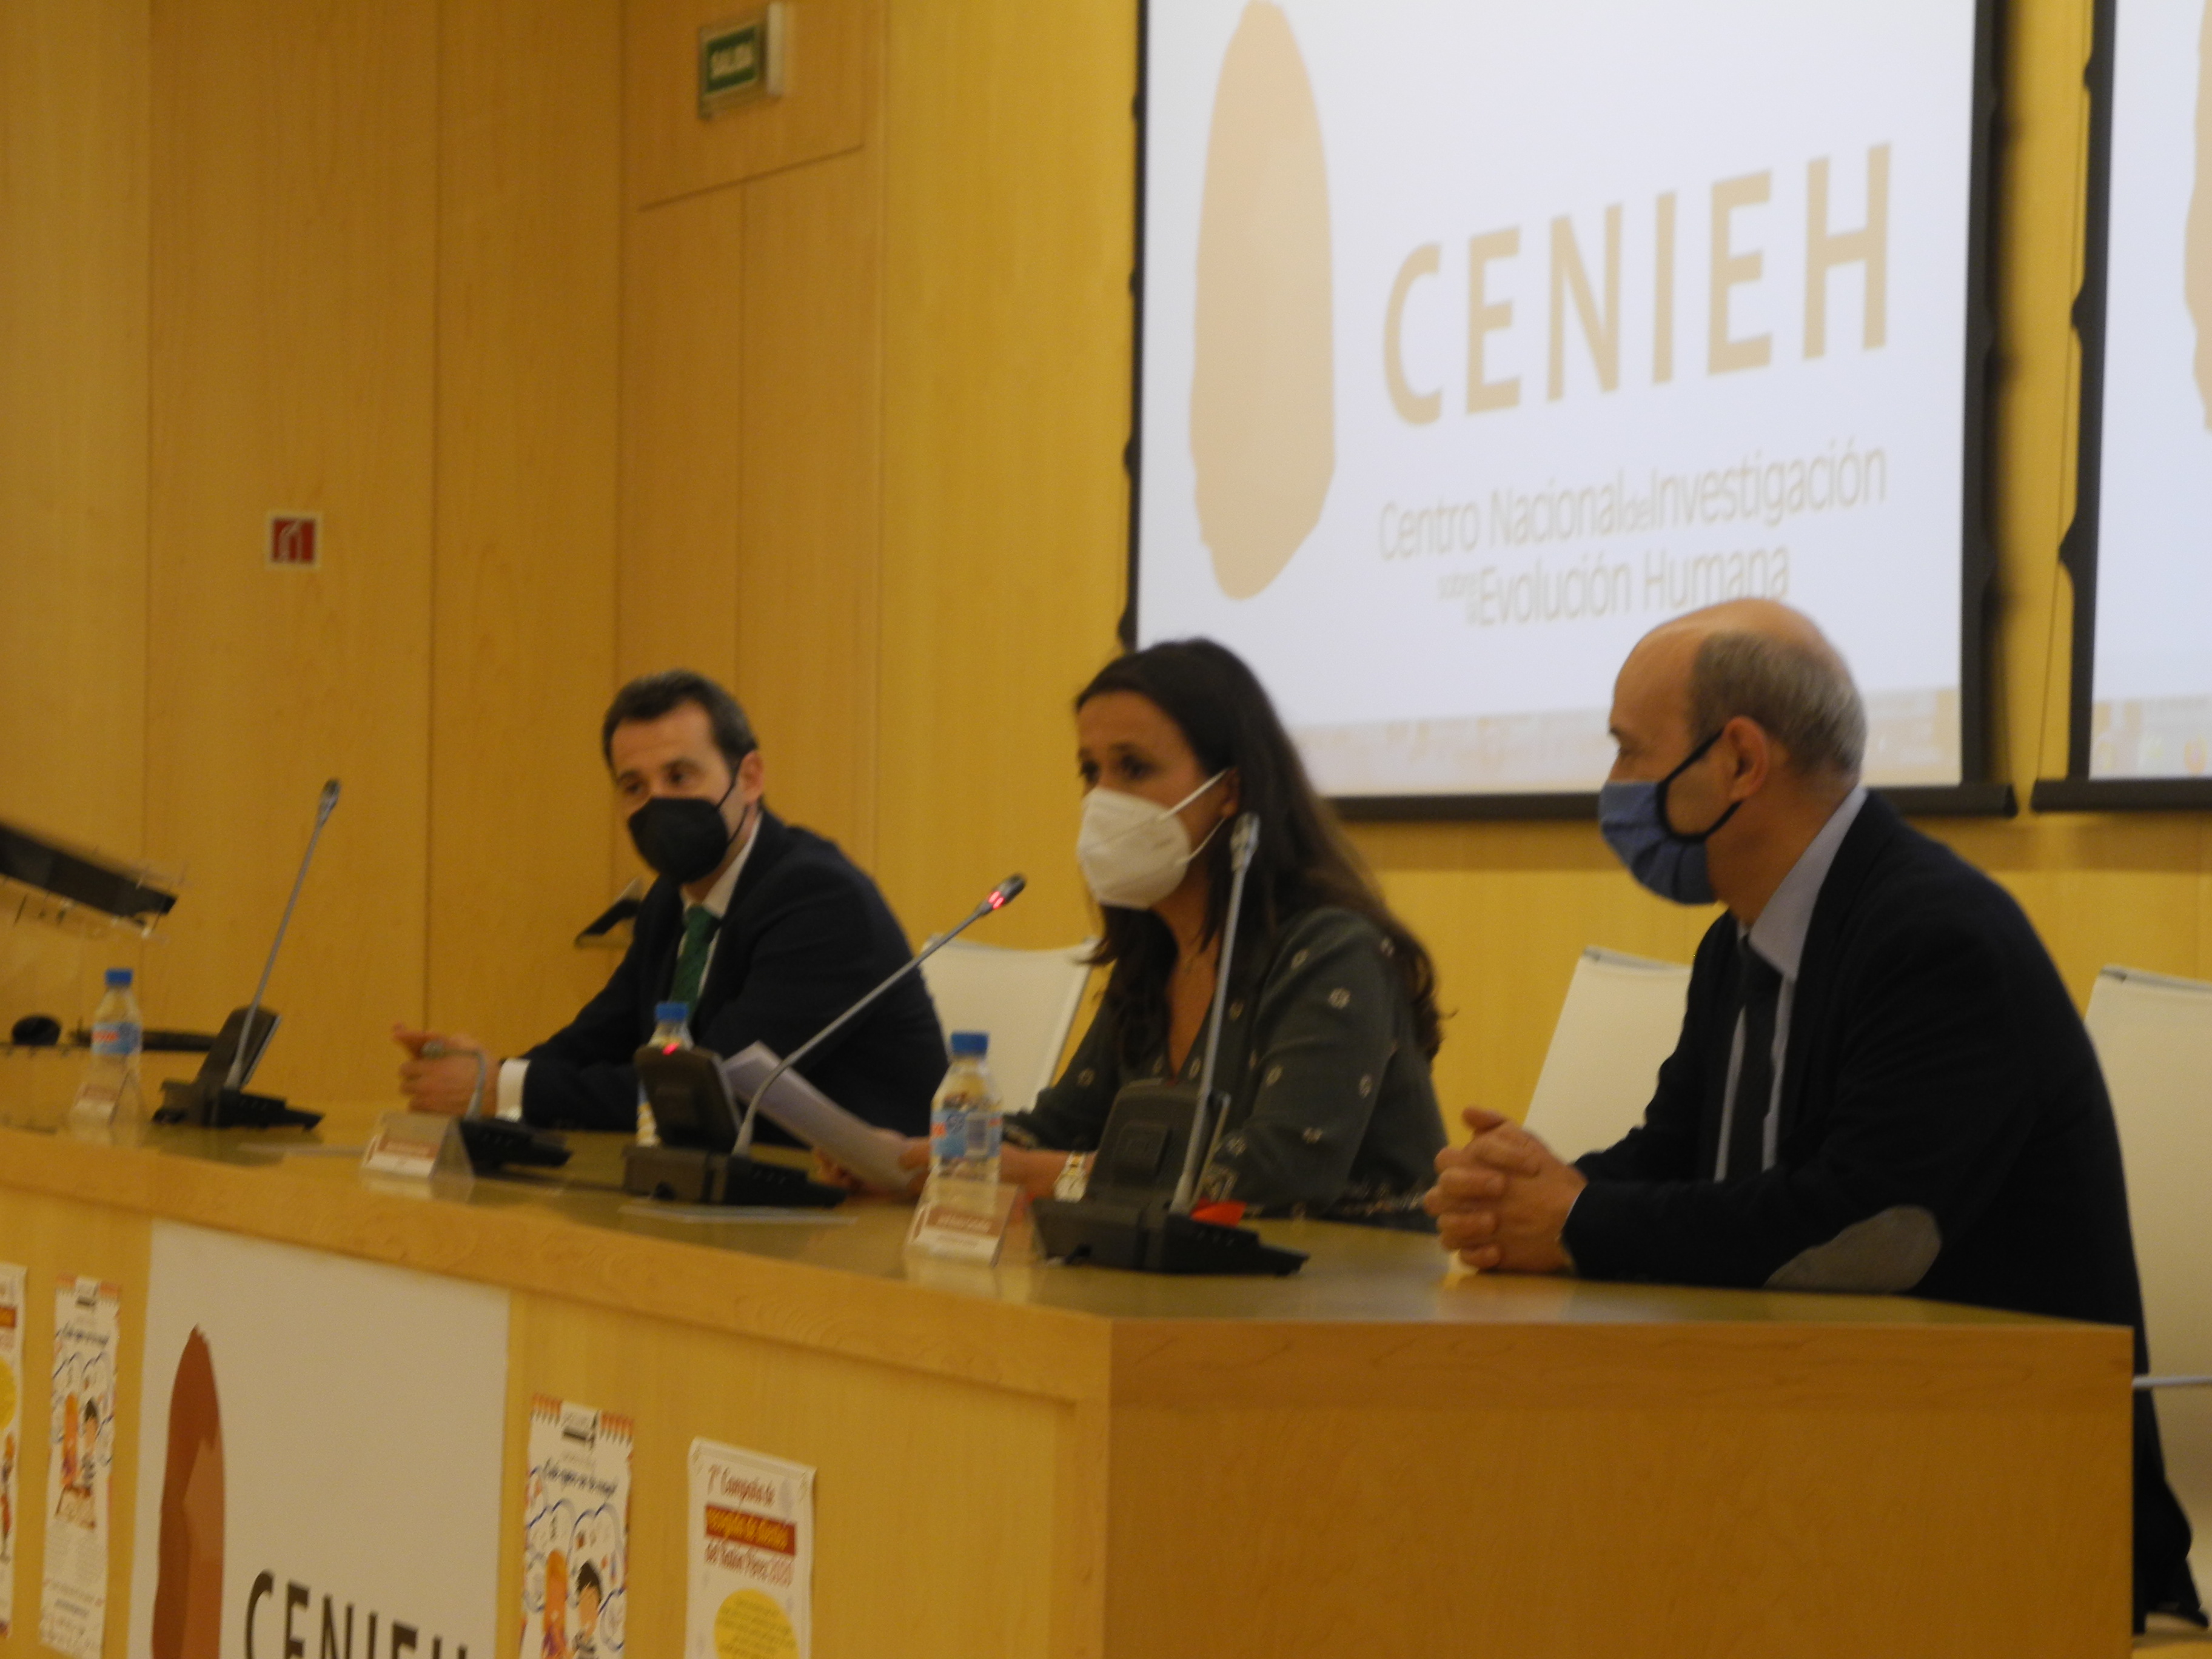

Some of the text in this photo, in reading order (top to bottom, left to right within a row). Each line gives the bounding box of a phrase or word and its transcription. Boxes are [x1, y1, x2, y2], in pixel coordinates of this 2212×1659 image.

[1383, 141, 1892, 426] CENIEH
[1378, 498, 1480, 562] Centro
[1488, 468, 1626, 546] Nacional
[1650, 436, 1887, 529] Investigación
[1479, 551, 1633, 626] Evolución
[1643, 546, 1789, 610] Humana
[244, 1569, 468, 1659] CEN
